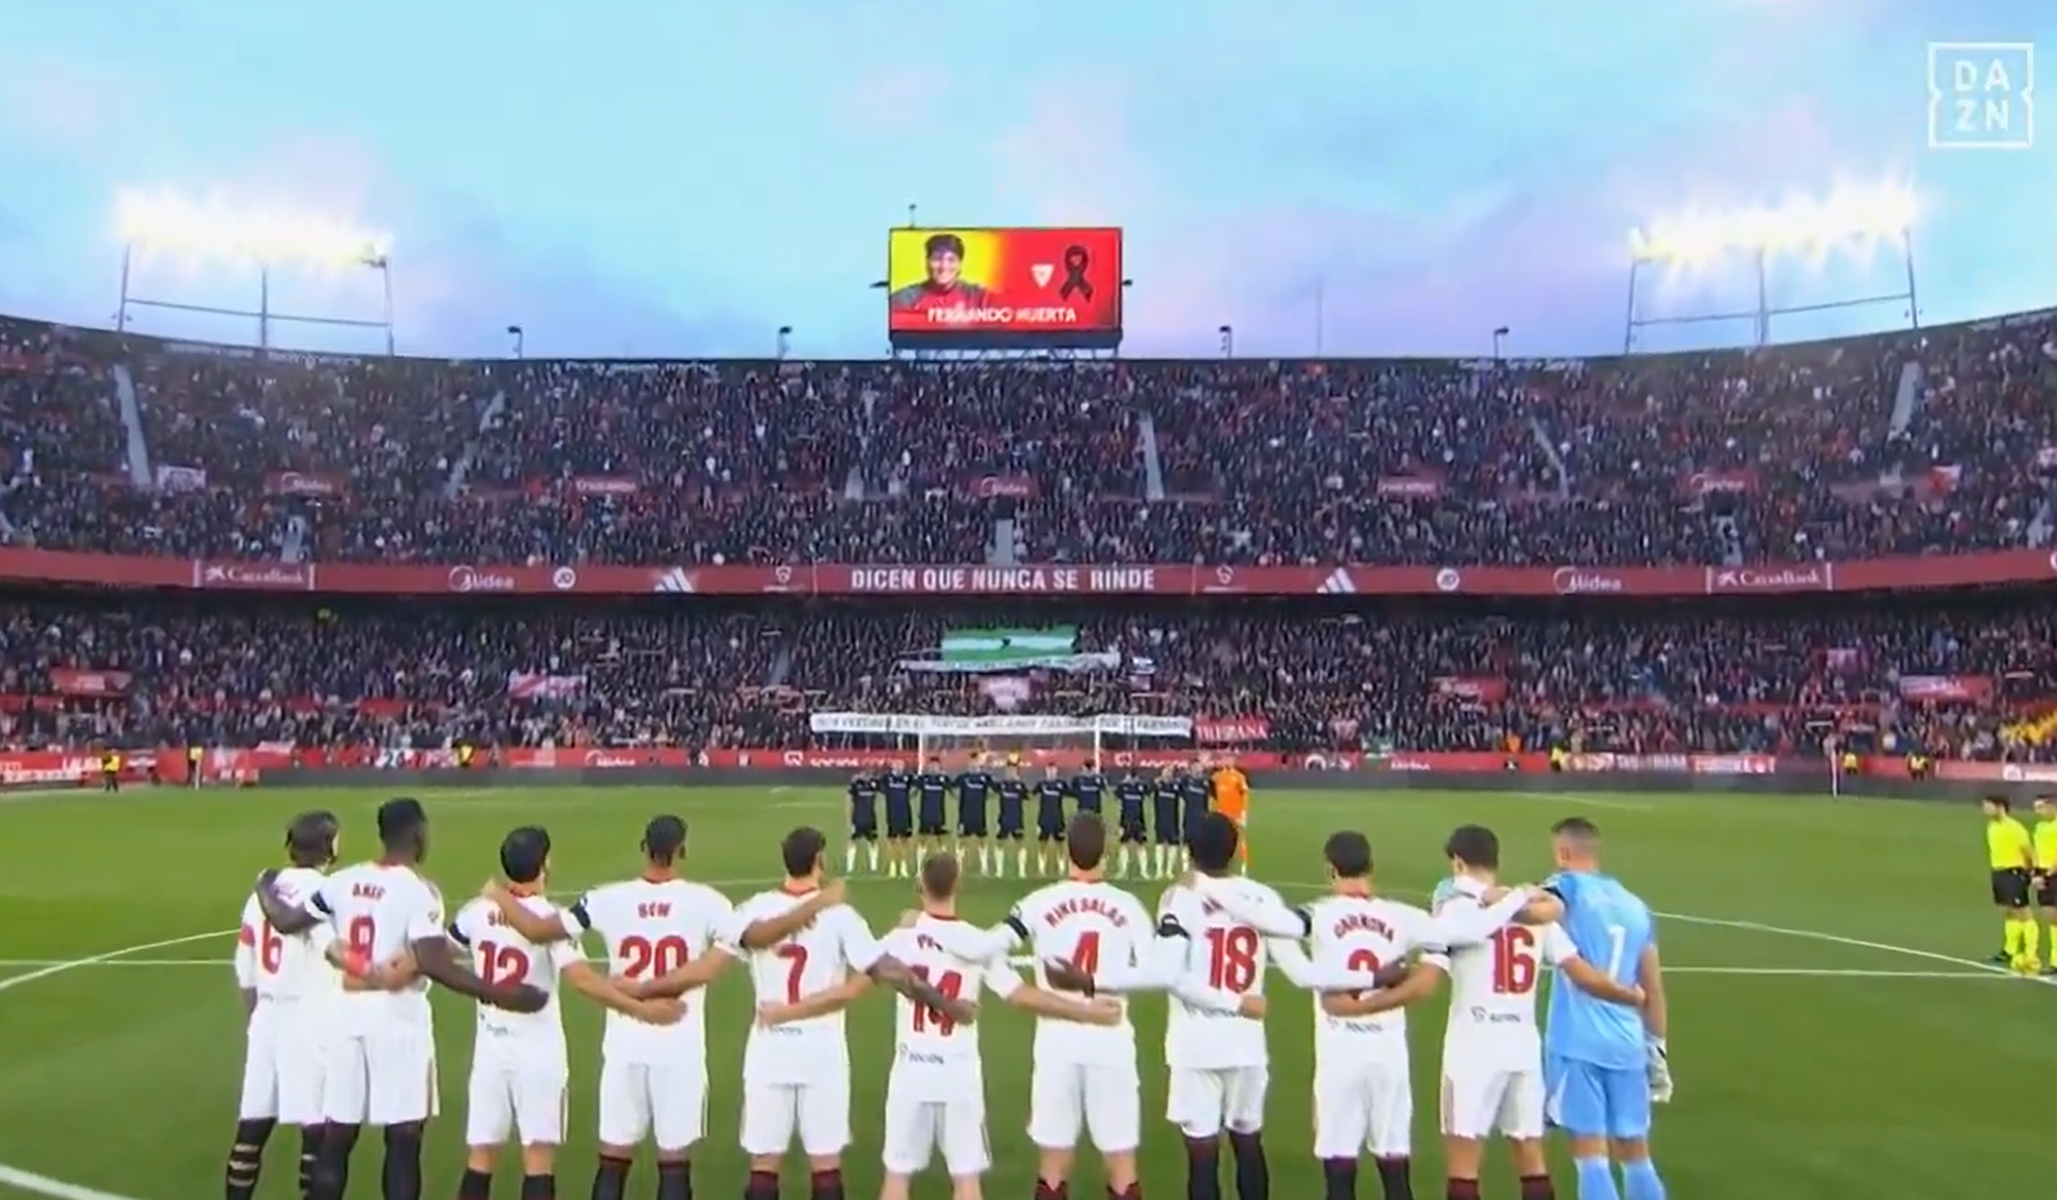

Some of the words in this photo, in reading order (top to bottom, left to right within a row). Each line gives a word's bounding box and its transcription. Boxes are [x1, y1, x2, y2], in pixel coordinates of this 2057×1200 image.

[927, 307, 1013, 322] FERNANDO
[448, 564, 514, 592] Midea
[851, 568, 915, 590] DICEN
[922, 568, 965, 590] QUE
[971, 568, 1047, 590] NUNCA
[1053, 568, 1078, 590] SE
[1090, 568, 1155, 590] RINDE
[1553, 566, 1622, 595] Midea
[261, 917, 284, 976] 6
[349, 915, 376, 967] 9
[477, 940, 529, 990] 12
[618, 934, 690, 981] 20
[1072, 930, 1101, 977] 4
[1204, 925, 1259, 995] 18
[1489, 922, 1536, 995] 16
[1608, 924, 1628, 980] 1
[777, 943, 808, 1005] 7
[910, 963, 962, 1037] 14
